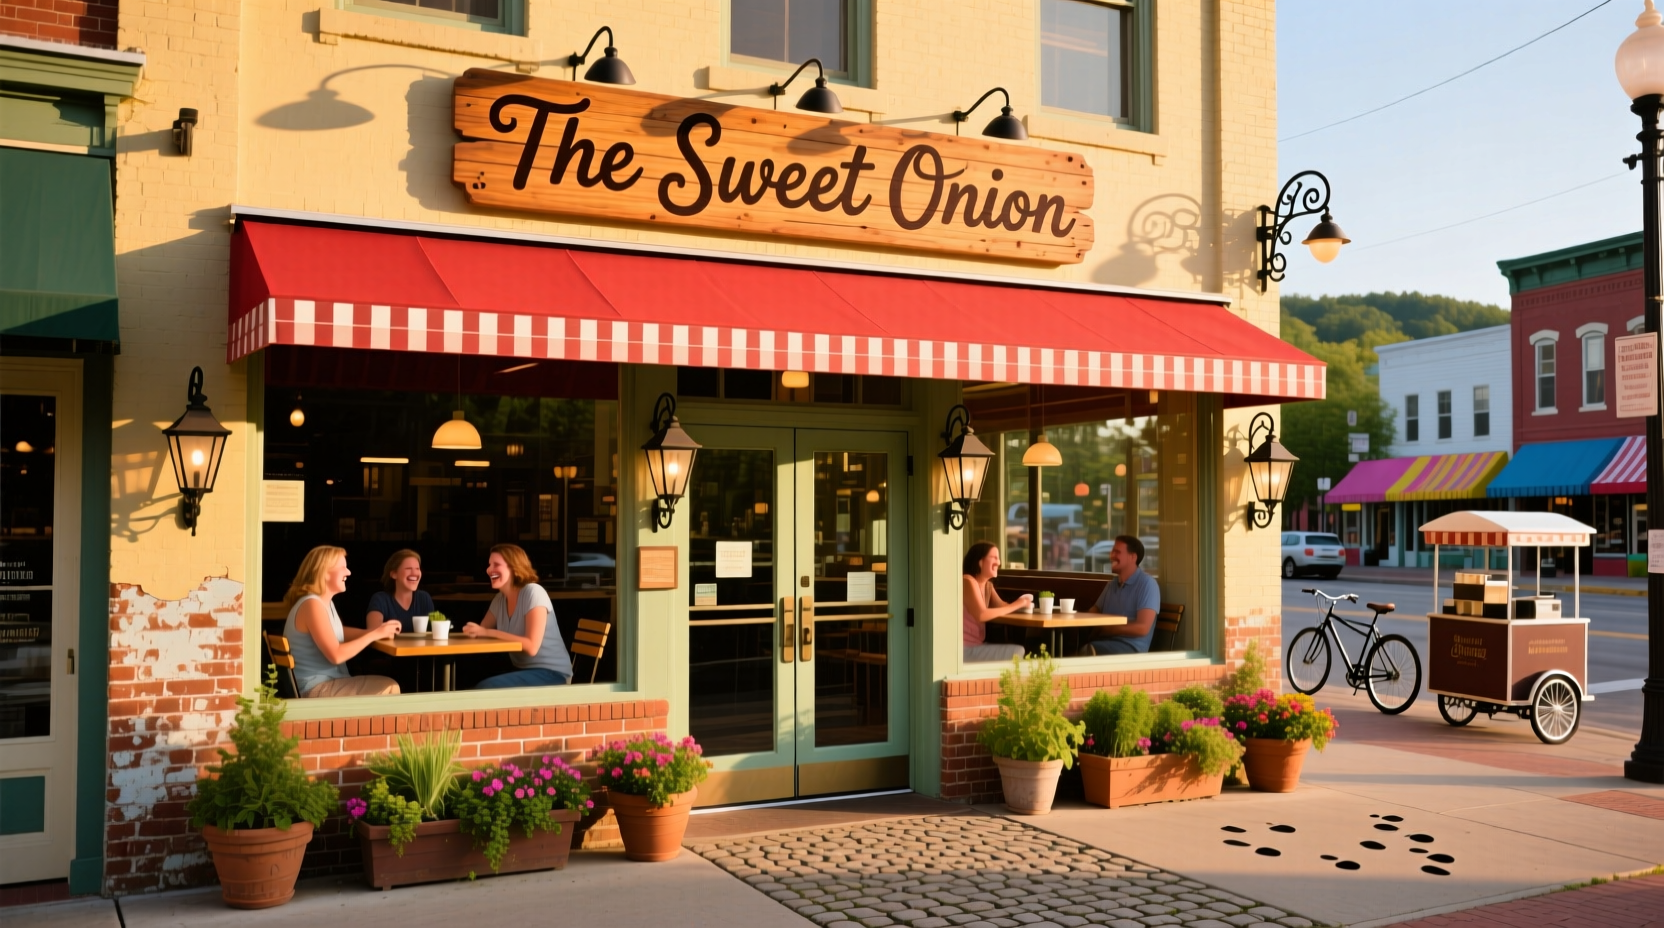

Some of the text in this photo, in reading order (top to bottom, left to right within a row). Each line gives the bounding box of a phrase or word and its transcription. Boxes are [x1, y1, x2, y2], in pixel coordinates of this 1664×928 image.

[489, 94, 1076, 238] The Sweet Onion
